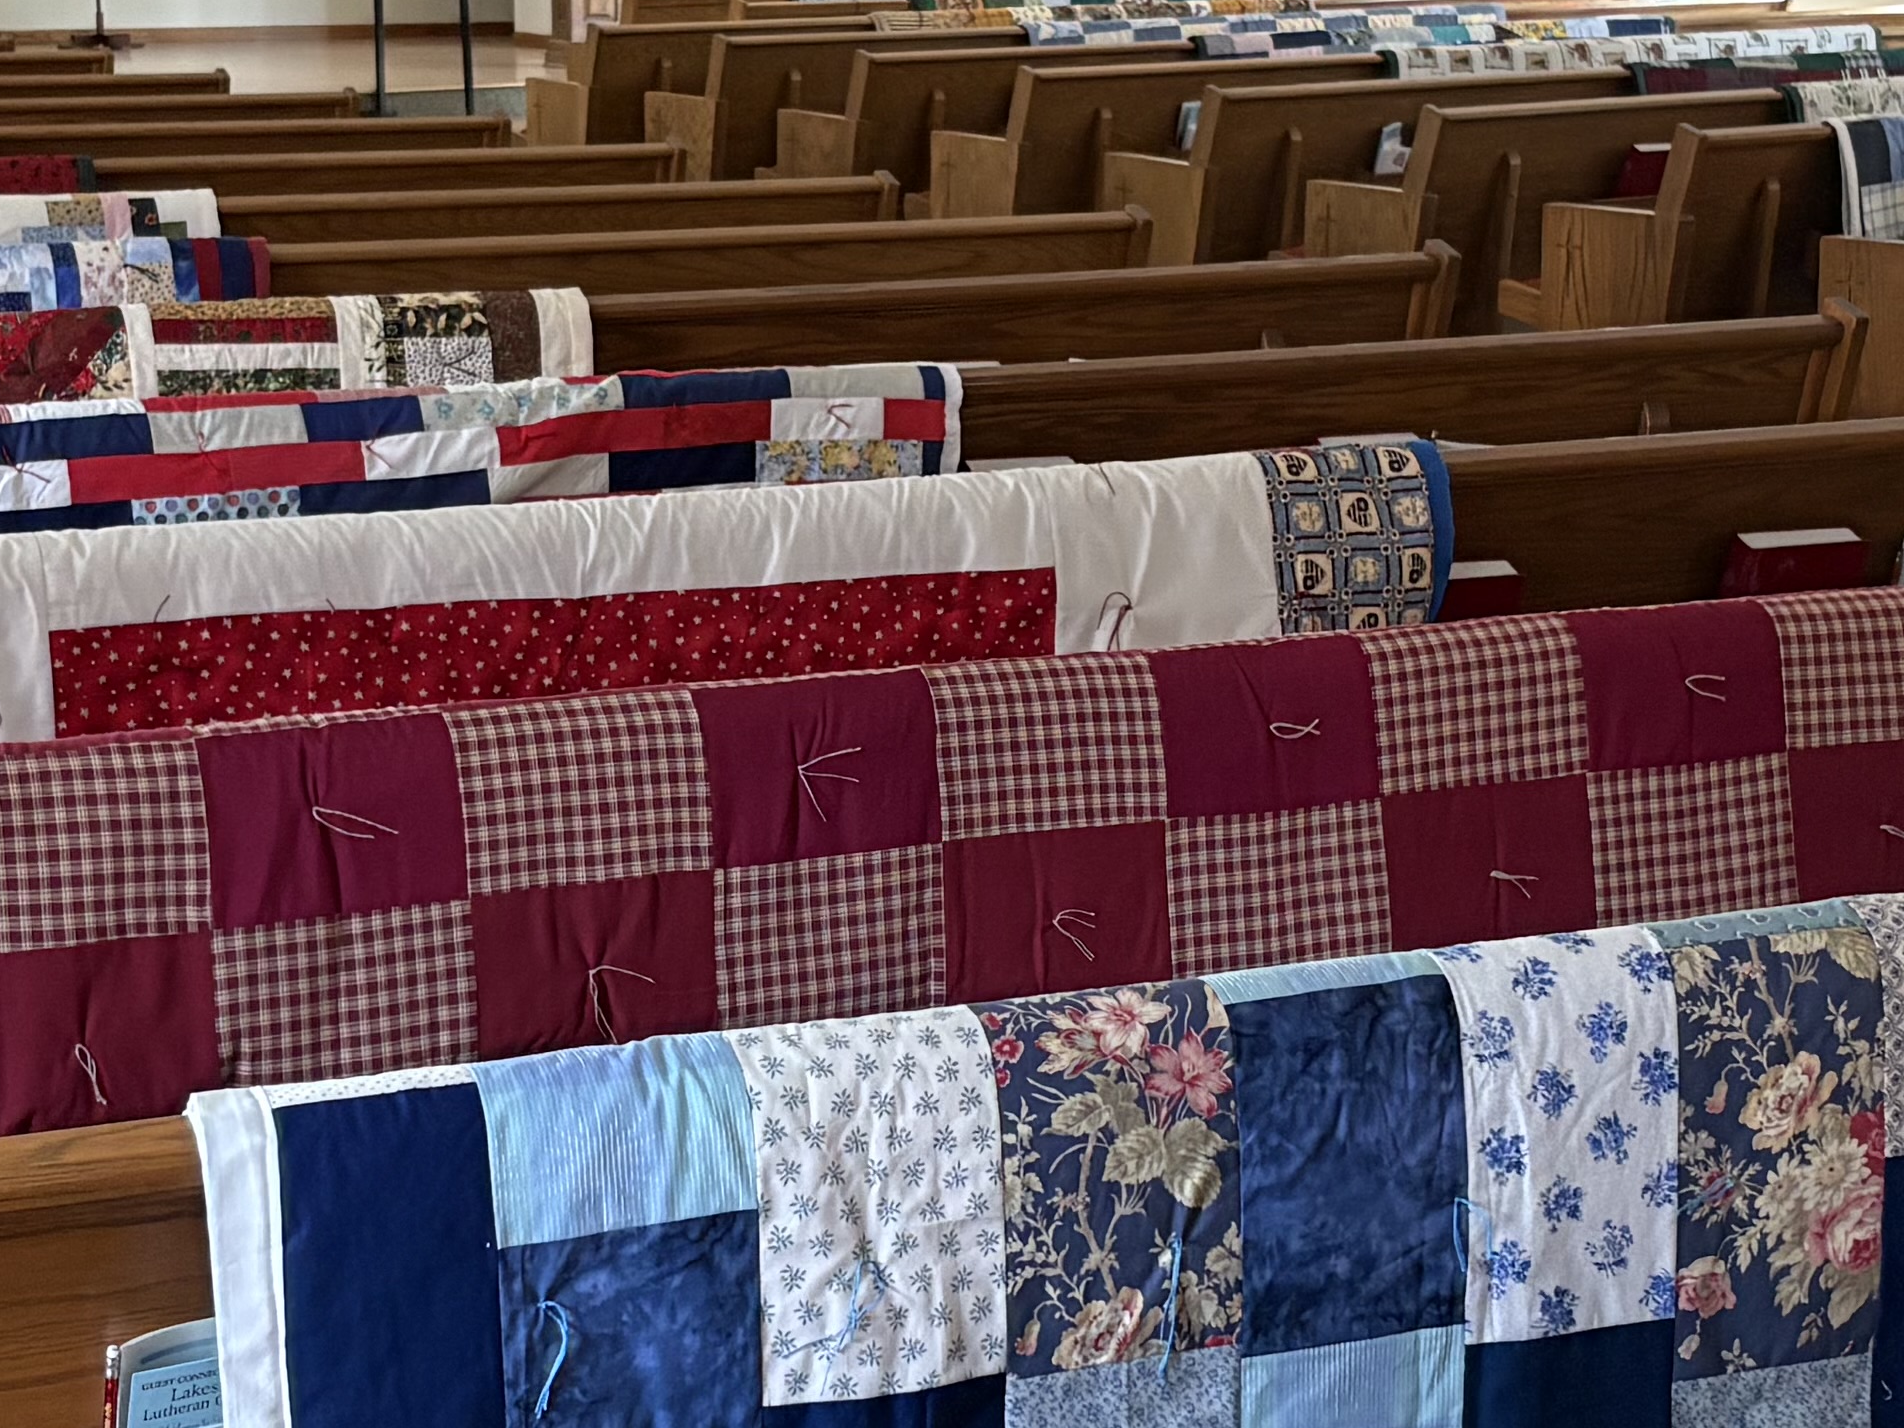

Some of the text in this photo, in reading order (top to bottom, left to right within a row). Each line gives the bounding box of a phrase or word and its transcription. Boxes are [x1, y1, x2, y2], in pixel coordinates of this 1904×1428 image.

[142, 1378, 175, 1391] GUEST
[171, 1384, 219, 1401] Lakes
[143, 1400, 210, 1421] Lutheran
